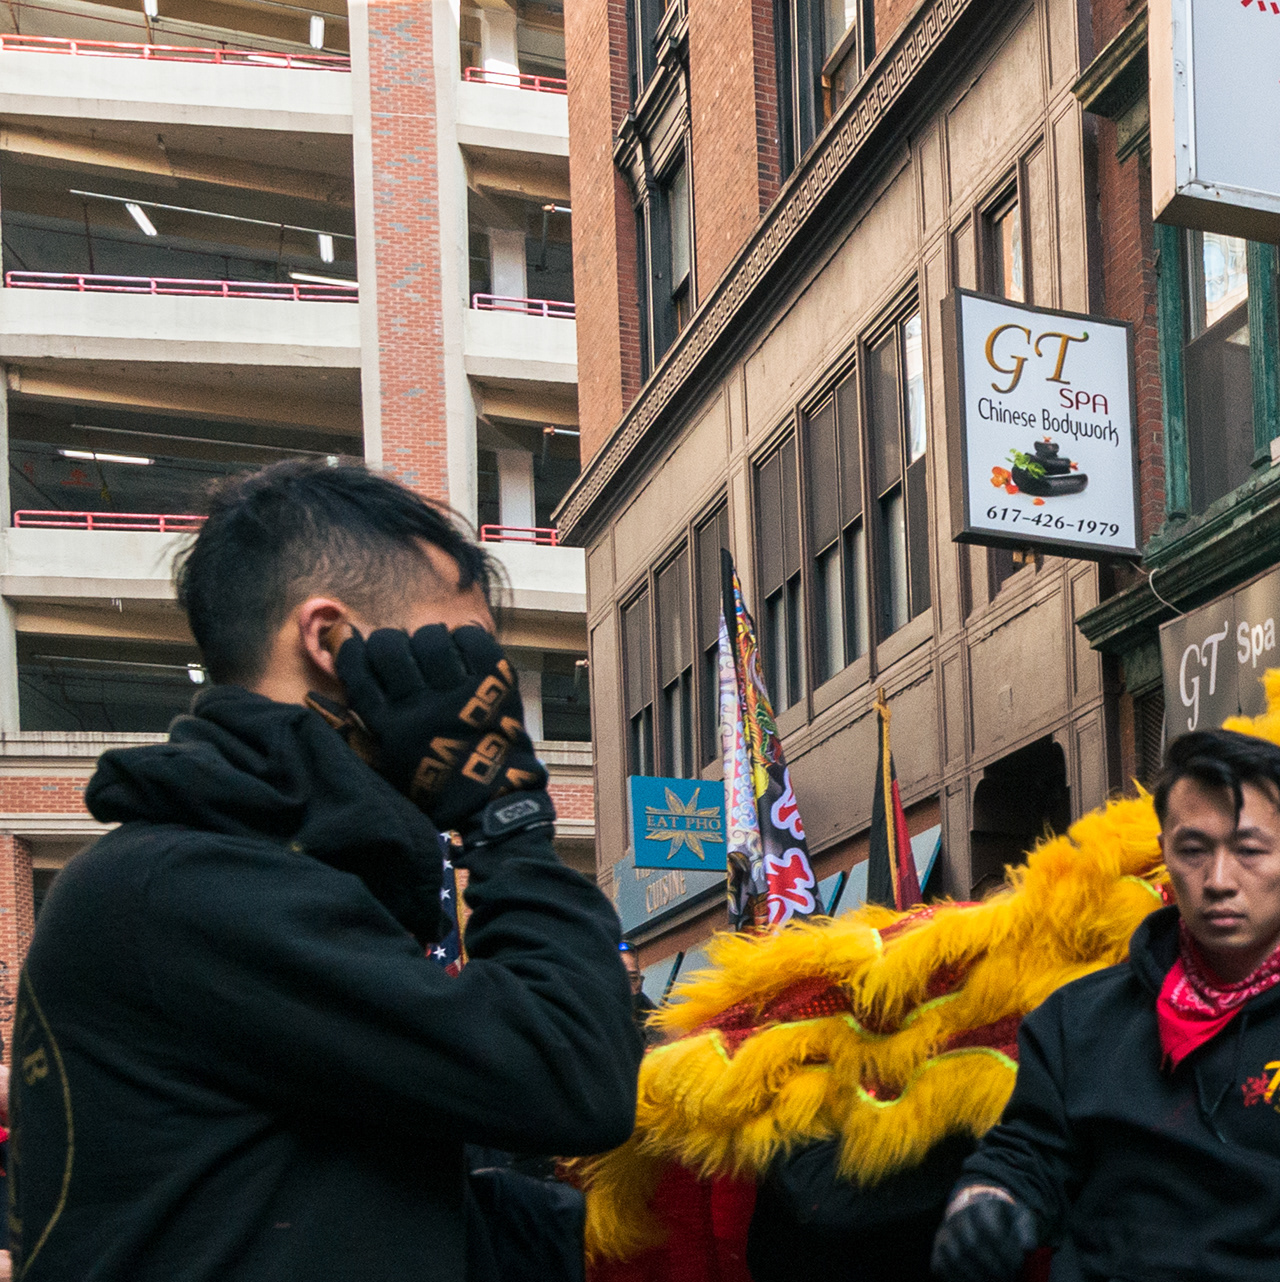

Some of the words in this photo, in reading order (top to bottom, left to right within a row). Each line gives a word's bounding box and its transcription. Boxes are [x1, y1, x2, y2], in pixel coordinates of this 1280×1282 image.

[984, 323, 1090, 395] GT
[1059, 387, 1110, 415] SPA
[978, 397, 1037, 429] Chinese
[1042, 408, 1120, 448] Bodywork
[986, 505, 1120, 537] 617-426-1979
[1178, 620, 1229, 731] GT
[1237, 617, 1276, 668] Spa
[646, 814, 679, 830] EAT
[686, 816, 722, 832] PHO
